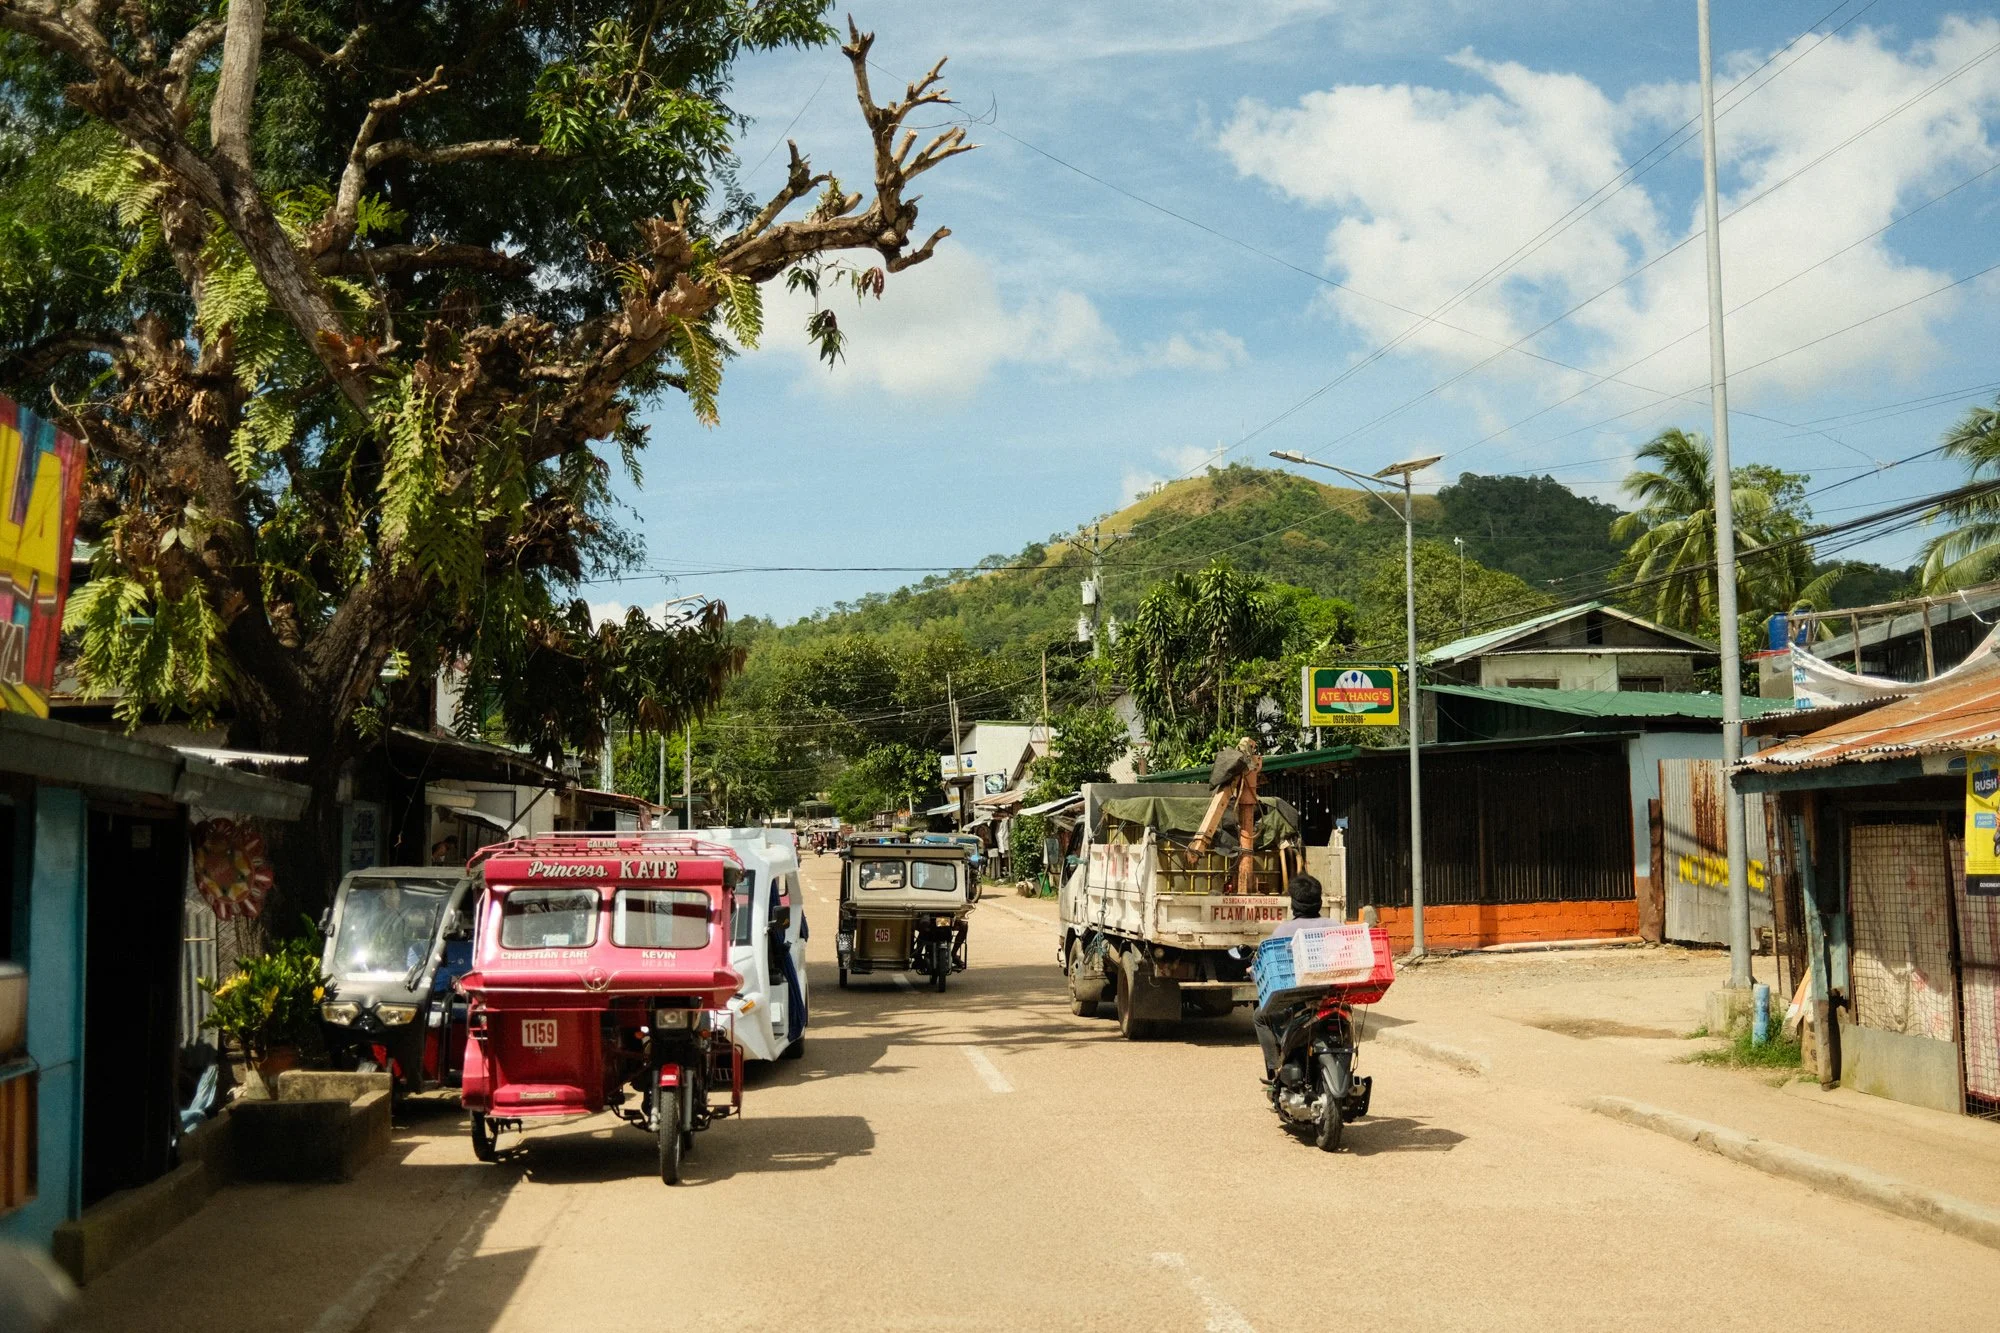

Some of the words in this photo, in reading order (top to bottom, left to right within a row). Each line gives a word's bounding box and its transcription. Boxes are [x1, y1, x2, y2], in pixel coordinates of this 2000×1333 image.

[1320, 692, 1340, 701] ATE
[1975, 778, 1998, 792] RUSH
[619, 861, 678, 879] KATE
[1679, 853, 1701, 885] NO
[876, 930, 889, 941] 405
[501, 952, 558, 960] CHRISTIAN
[642, 951, 676, 959] KEVIN
[525, 1023, 555, 1044] 1159
